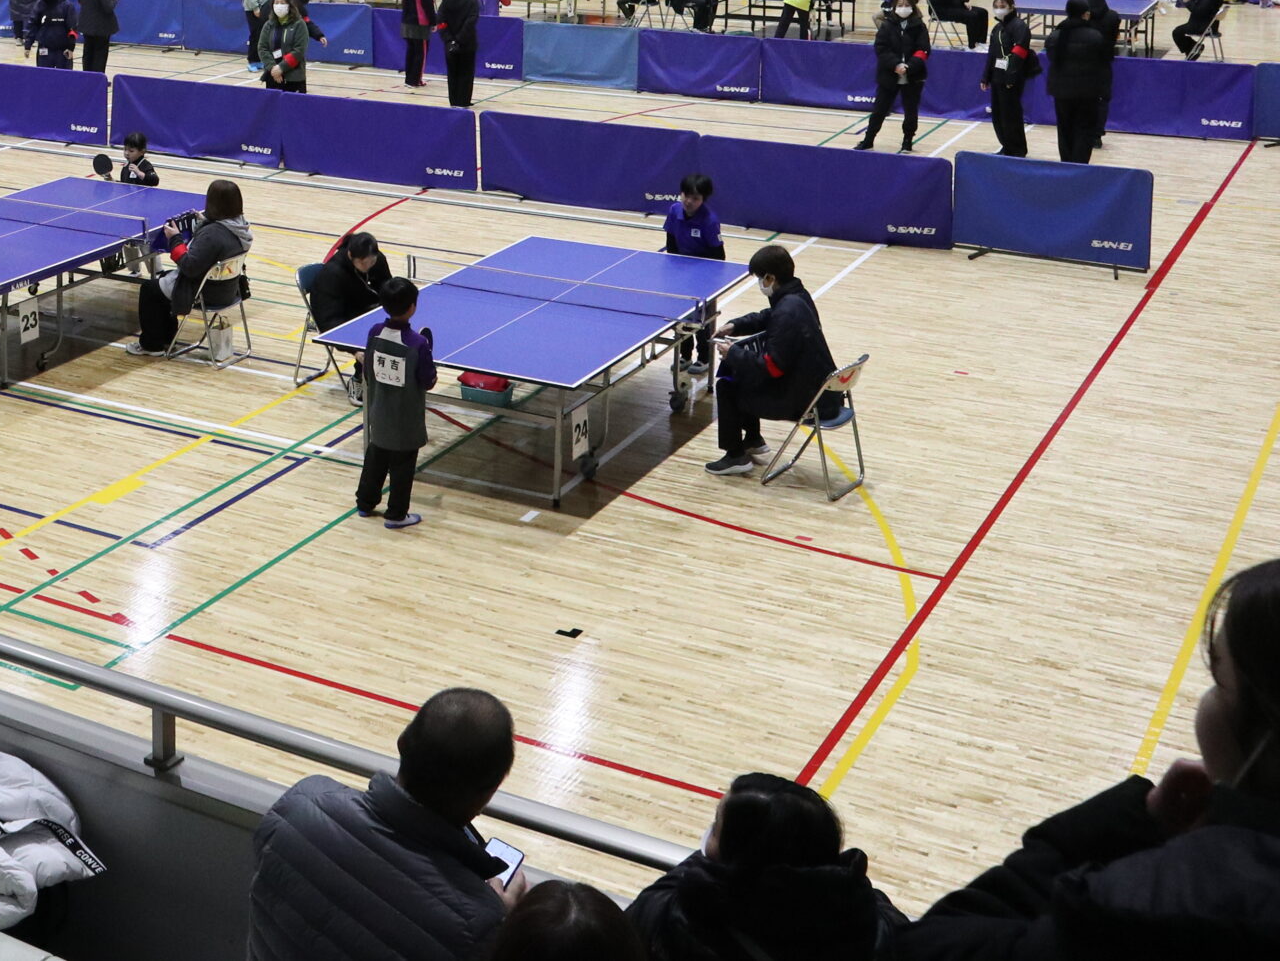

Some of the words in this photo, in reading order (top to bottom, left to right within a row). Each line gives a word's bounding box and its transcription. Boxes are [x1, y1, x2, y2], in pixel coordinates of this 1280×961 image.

[11, 279, 30, 291] KAWAI
[21, 311, 37, 333] 23
[377, 355, 400, 371] 有吉
[573, 419, 587, 446] 24
